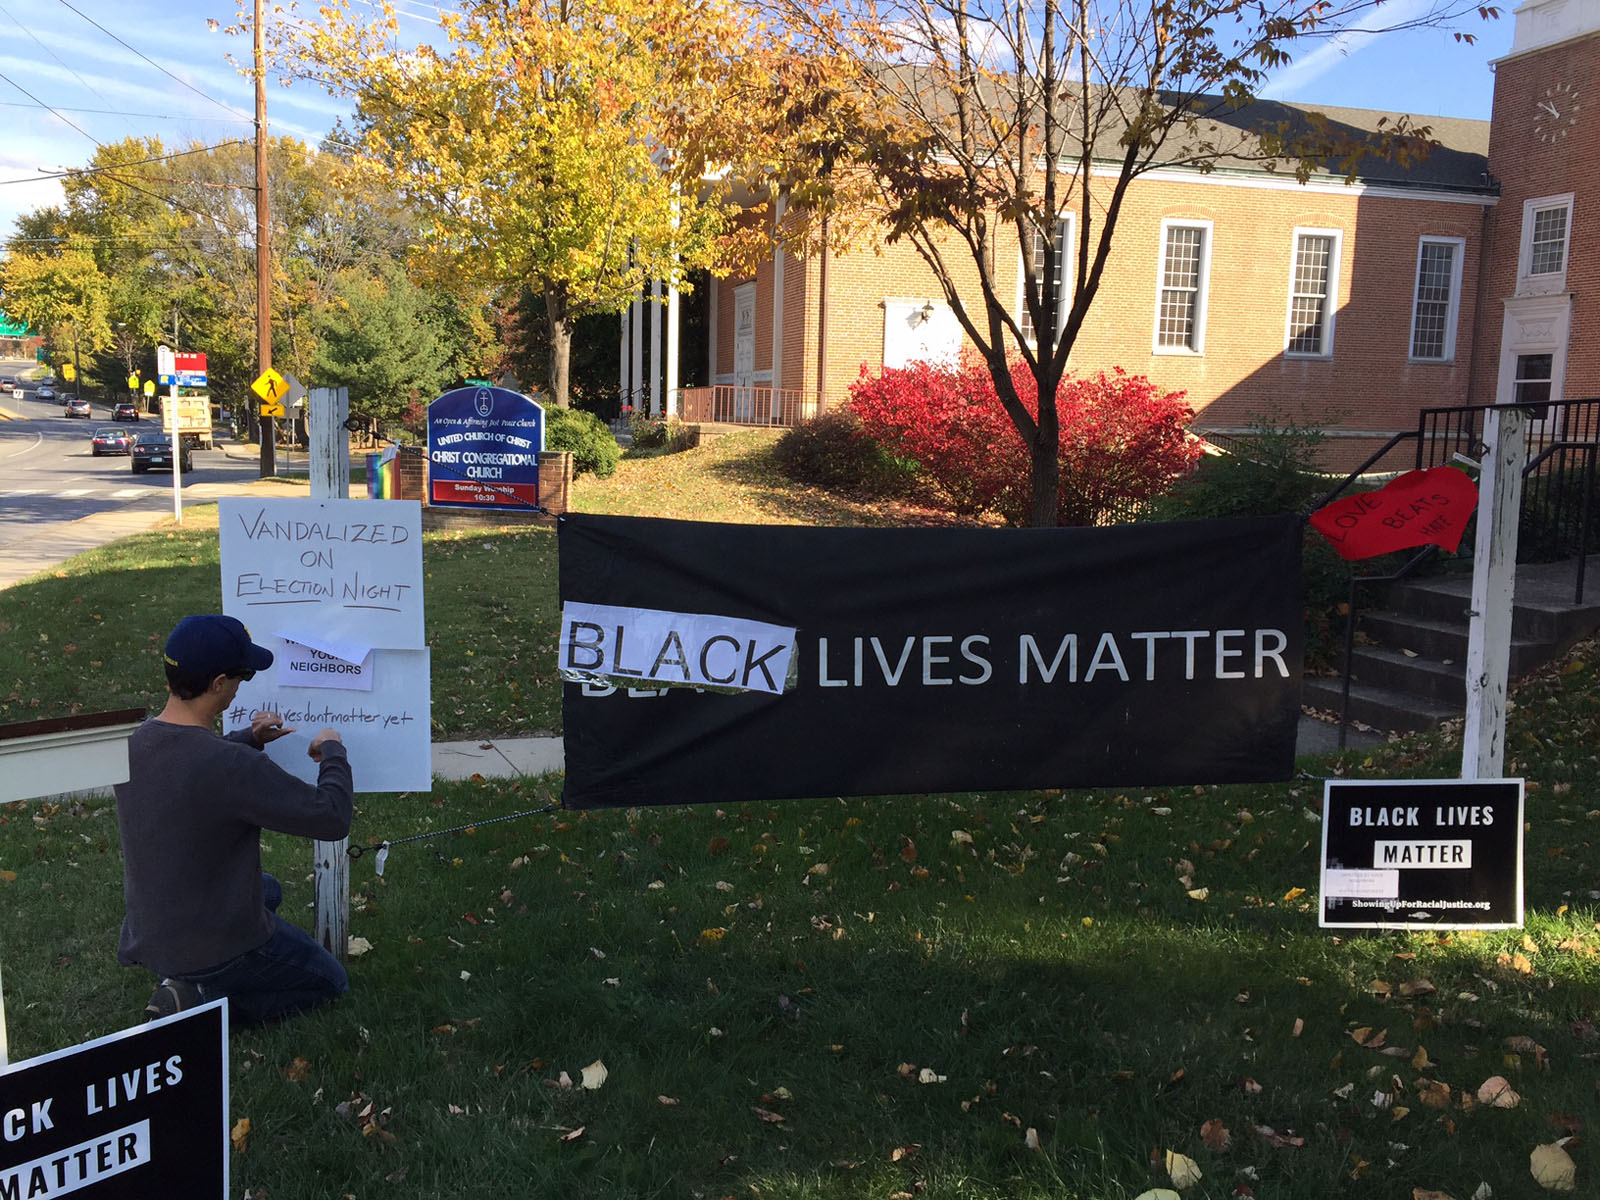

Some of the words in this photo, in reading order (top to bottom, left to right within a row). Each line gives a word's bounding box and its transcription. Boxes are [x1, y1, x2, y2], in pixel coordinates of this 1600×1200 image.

[443, 418, 456, 427] Open
[463, 416, 488, 428] Affirming
[516, 418, 536, 428] Church
[437, 432, 463, 446] UNITED
[464, 432, 494, 441] CHURCH
[506, 435, 532, 449] CHRIST
[432, 451, 460, 463] CHRIST
[462, 452, 537, 466] CONGREGATIONAL
[466, 466, 502, 479] CHURCH
[454, 483, 482, 493] Sunday
[1327, 493, 1383, 543] LOVE
[1382, 494, 1449, 529] BEATS
[238, 508, 409, 544] VANDALIZED
[1419, 515, 1452, 536] HATE
[300, 548, 333, 569] ON
[236, 573, 334, 598] ELECTION
[342, 572, 411, 601] NIGHT
[310, 649, 338, 660] YOU
[567, 620, 787, 691] BLACK
[819, 635, 993, 687] LIVES
[1019, 629, 1290, 684] MATTER
[290, 661, 362, 675] NEIGHBORS
[1350, 807, 1420, 827] BLACK
[1436, 806, 1494, 826] LIVES
[1383, 845, 1464, 864] MATTER
[1352, 899, 1491, 911] ShowingUpForRacialJustice.org
[86, 1055, 183, 1116] LIVES
[0, 1132, 138, 1200] MATTER
